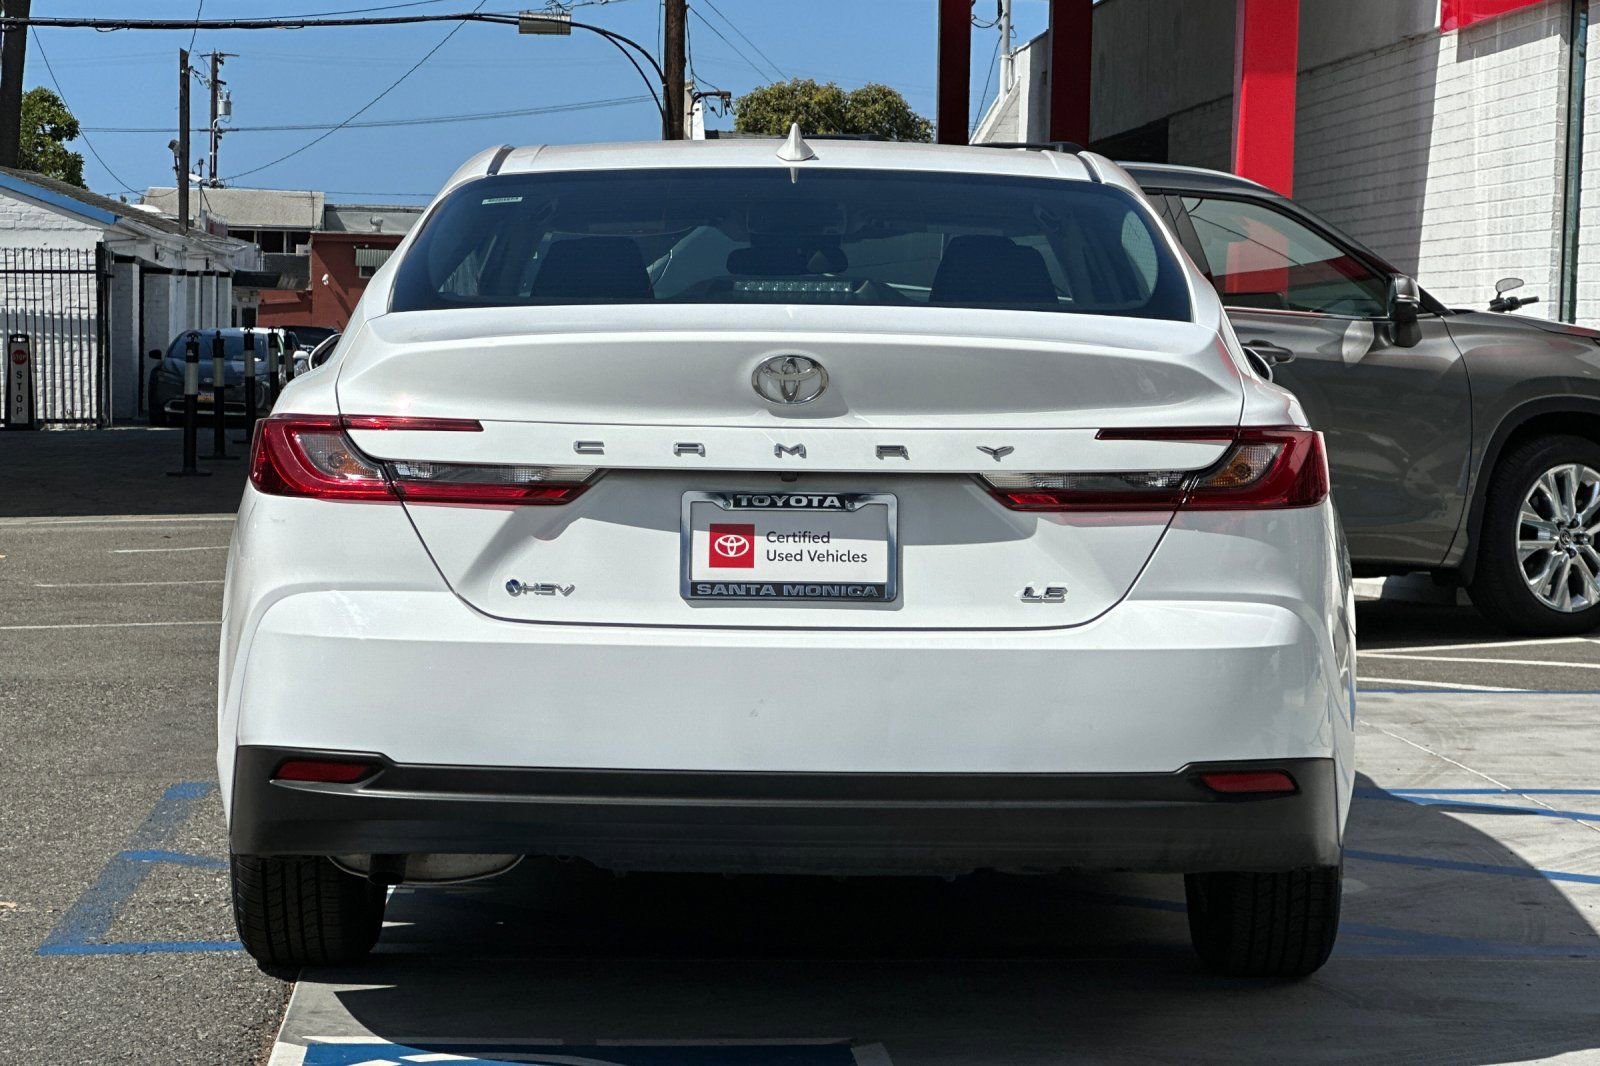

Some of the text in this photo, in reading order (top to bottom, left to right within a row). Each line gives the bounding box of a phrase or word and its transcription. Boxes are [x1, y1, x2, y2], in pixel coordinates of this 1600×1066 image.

[573, 440, 1014, 461] CAMRY
[735, 494, 842, 508] TOYOTA
[765, 530, 830, 544] Certified
[766, 549, 868, 563] Used Vehicles
[696, 583, 879, 597] SANTA MONICA
[1020, 586, 1068, 602] LE
